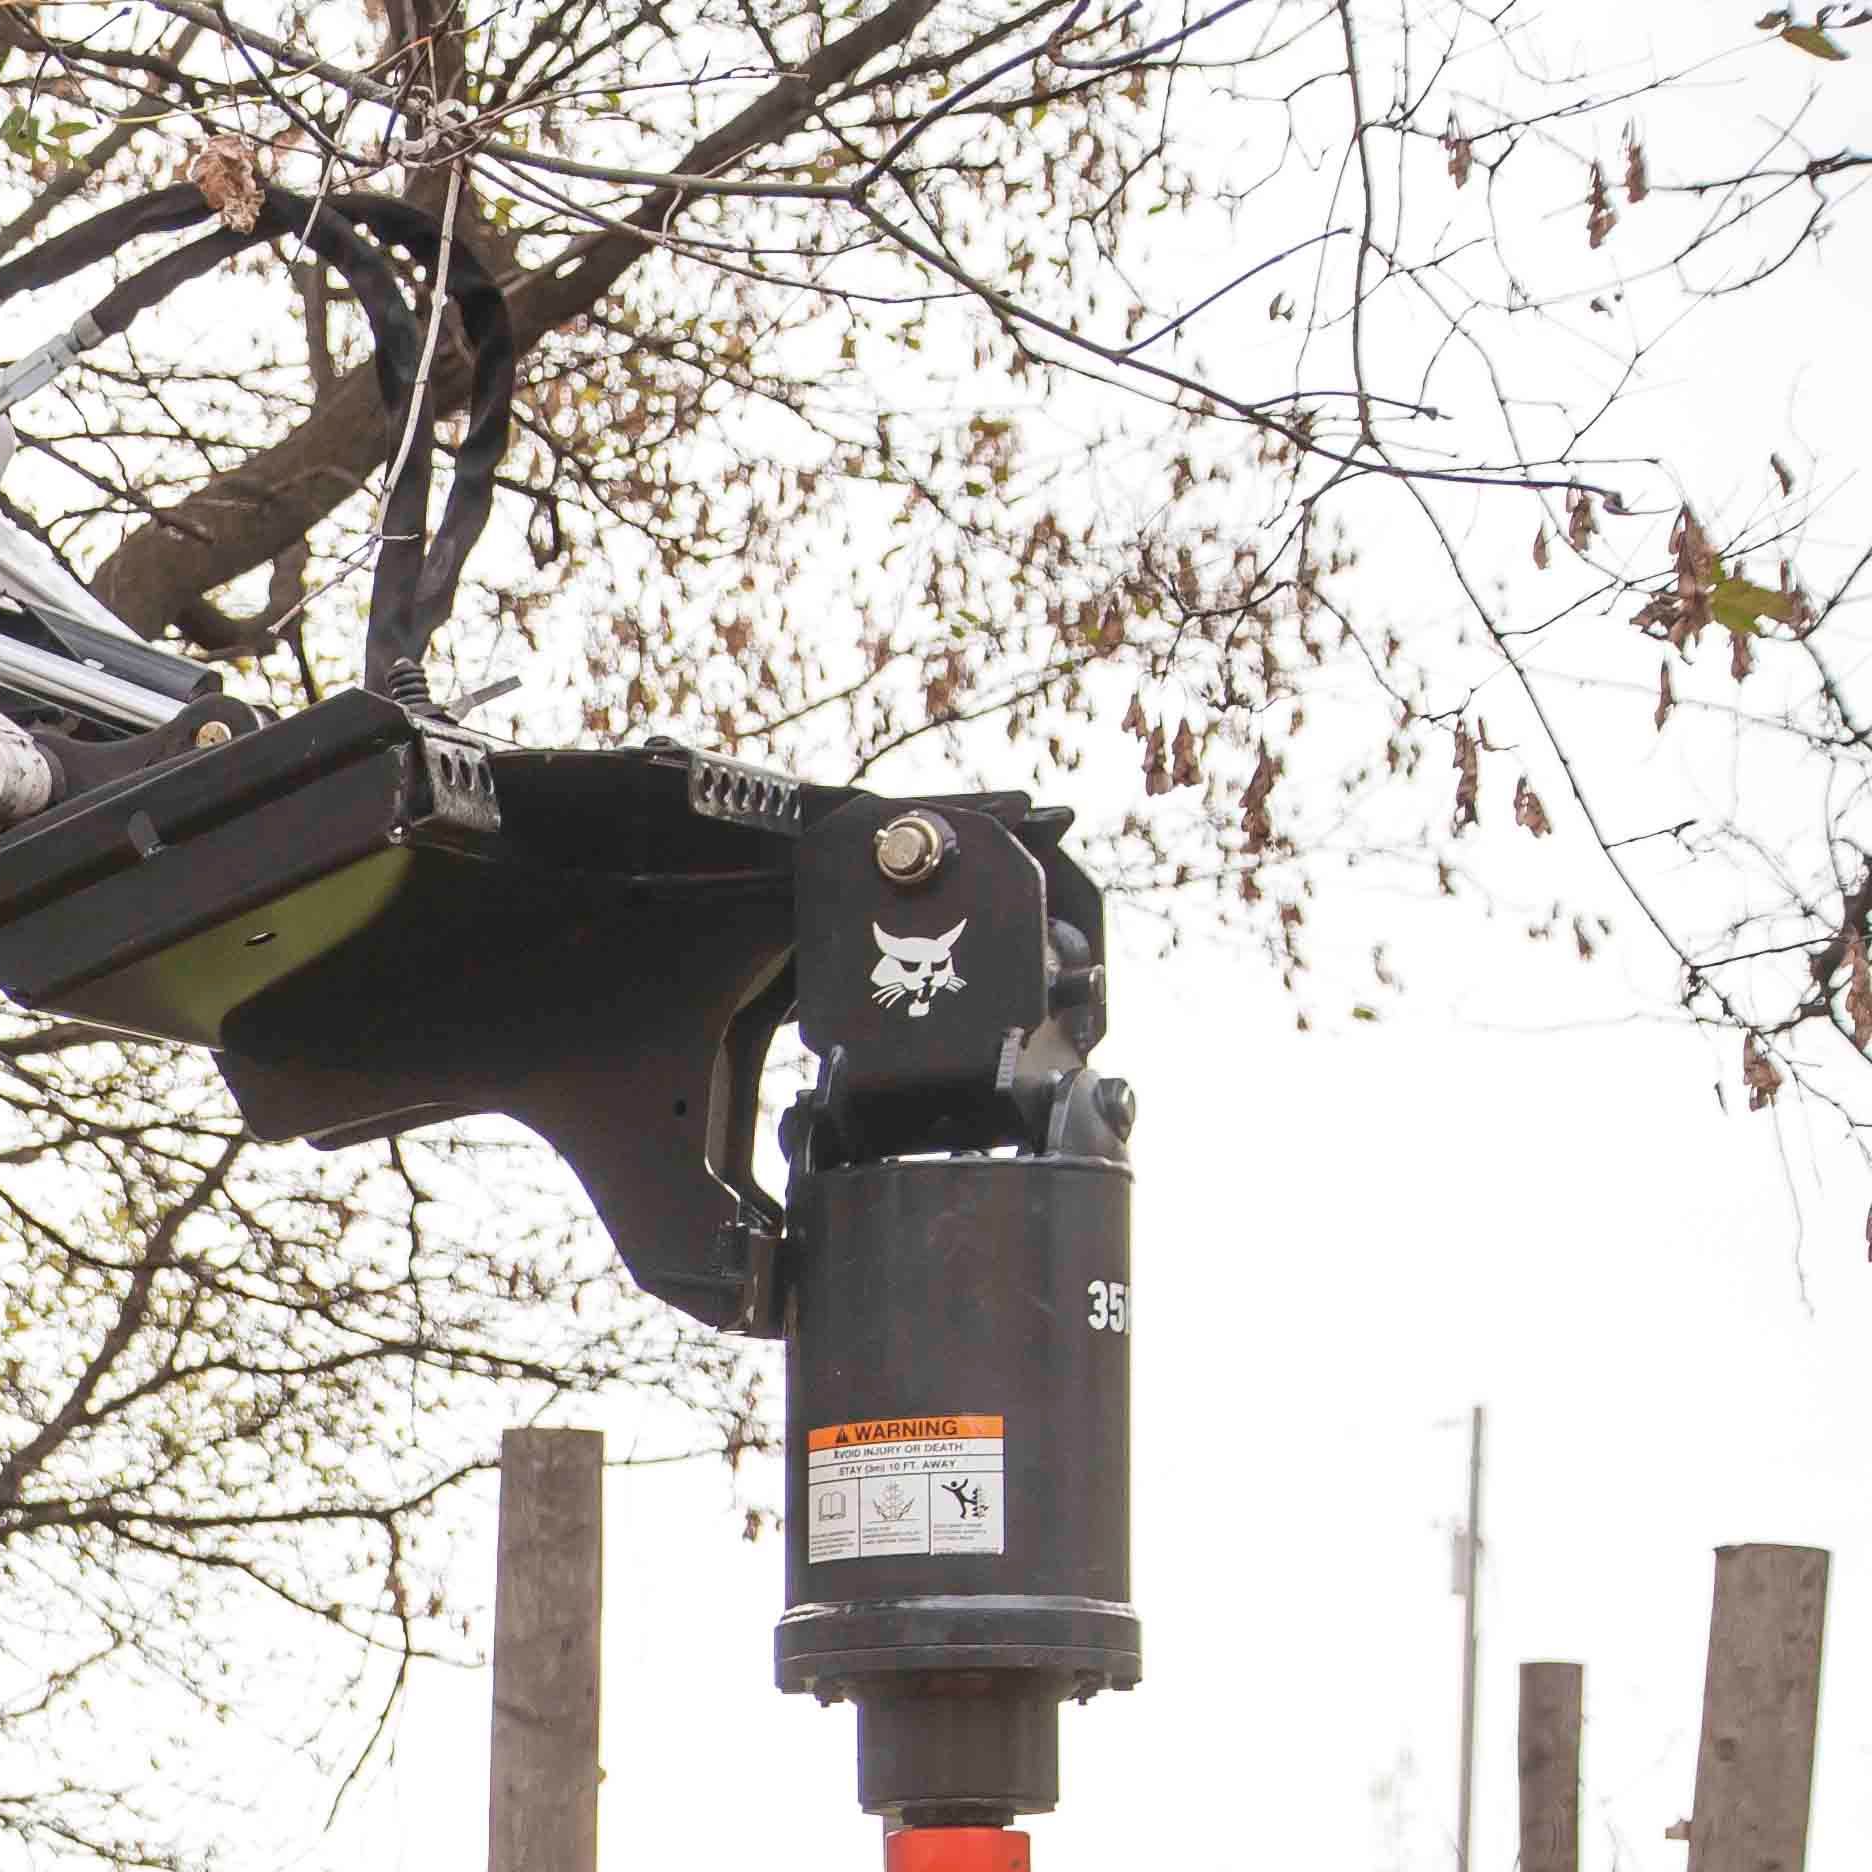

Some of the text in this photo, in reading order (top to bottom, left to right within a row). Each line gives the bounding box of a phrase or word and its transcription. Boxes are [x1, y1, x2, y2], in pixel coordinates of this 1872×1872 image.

[1088, 1280, 1129, 1332] 35
[856, 1420, 958, 1441] WARNING
[833, 1442, 963, 1460] AVOID INJURY OR DEATH
[840, 1466, 862, 1476] STAY
[922, 1460, 956, 1469] AWAY
